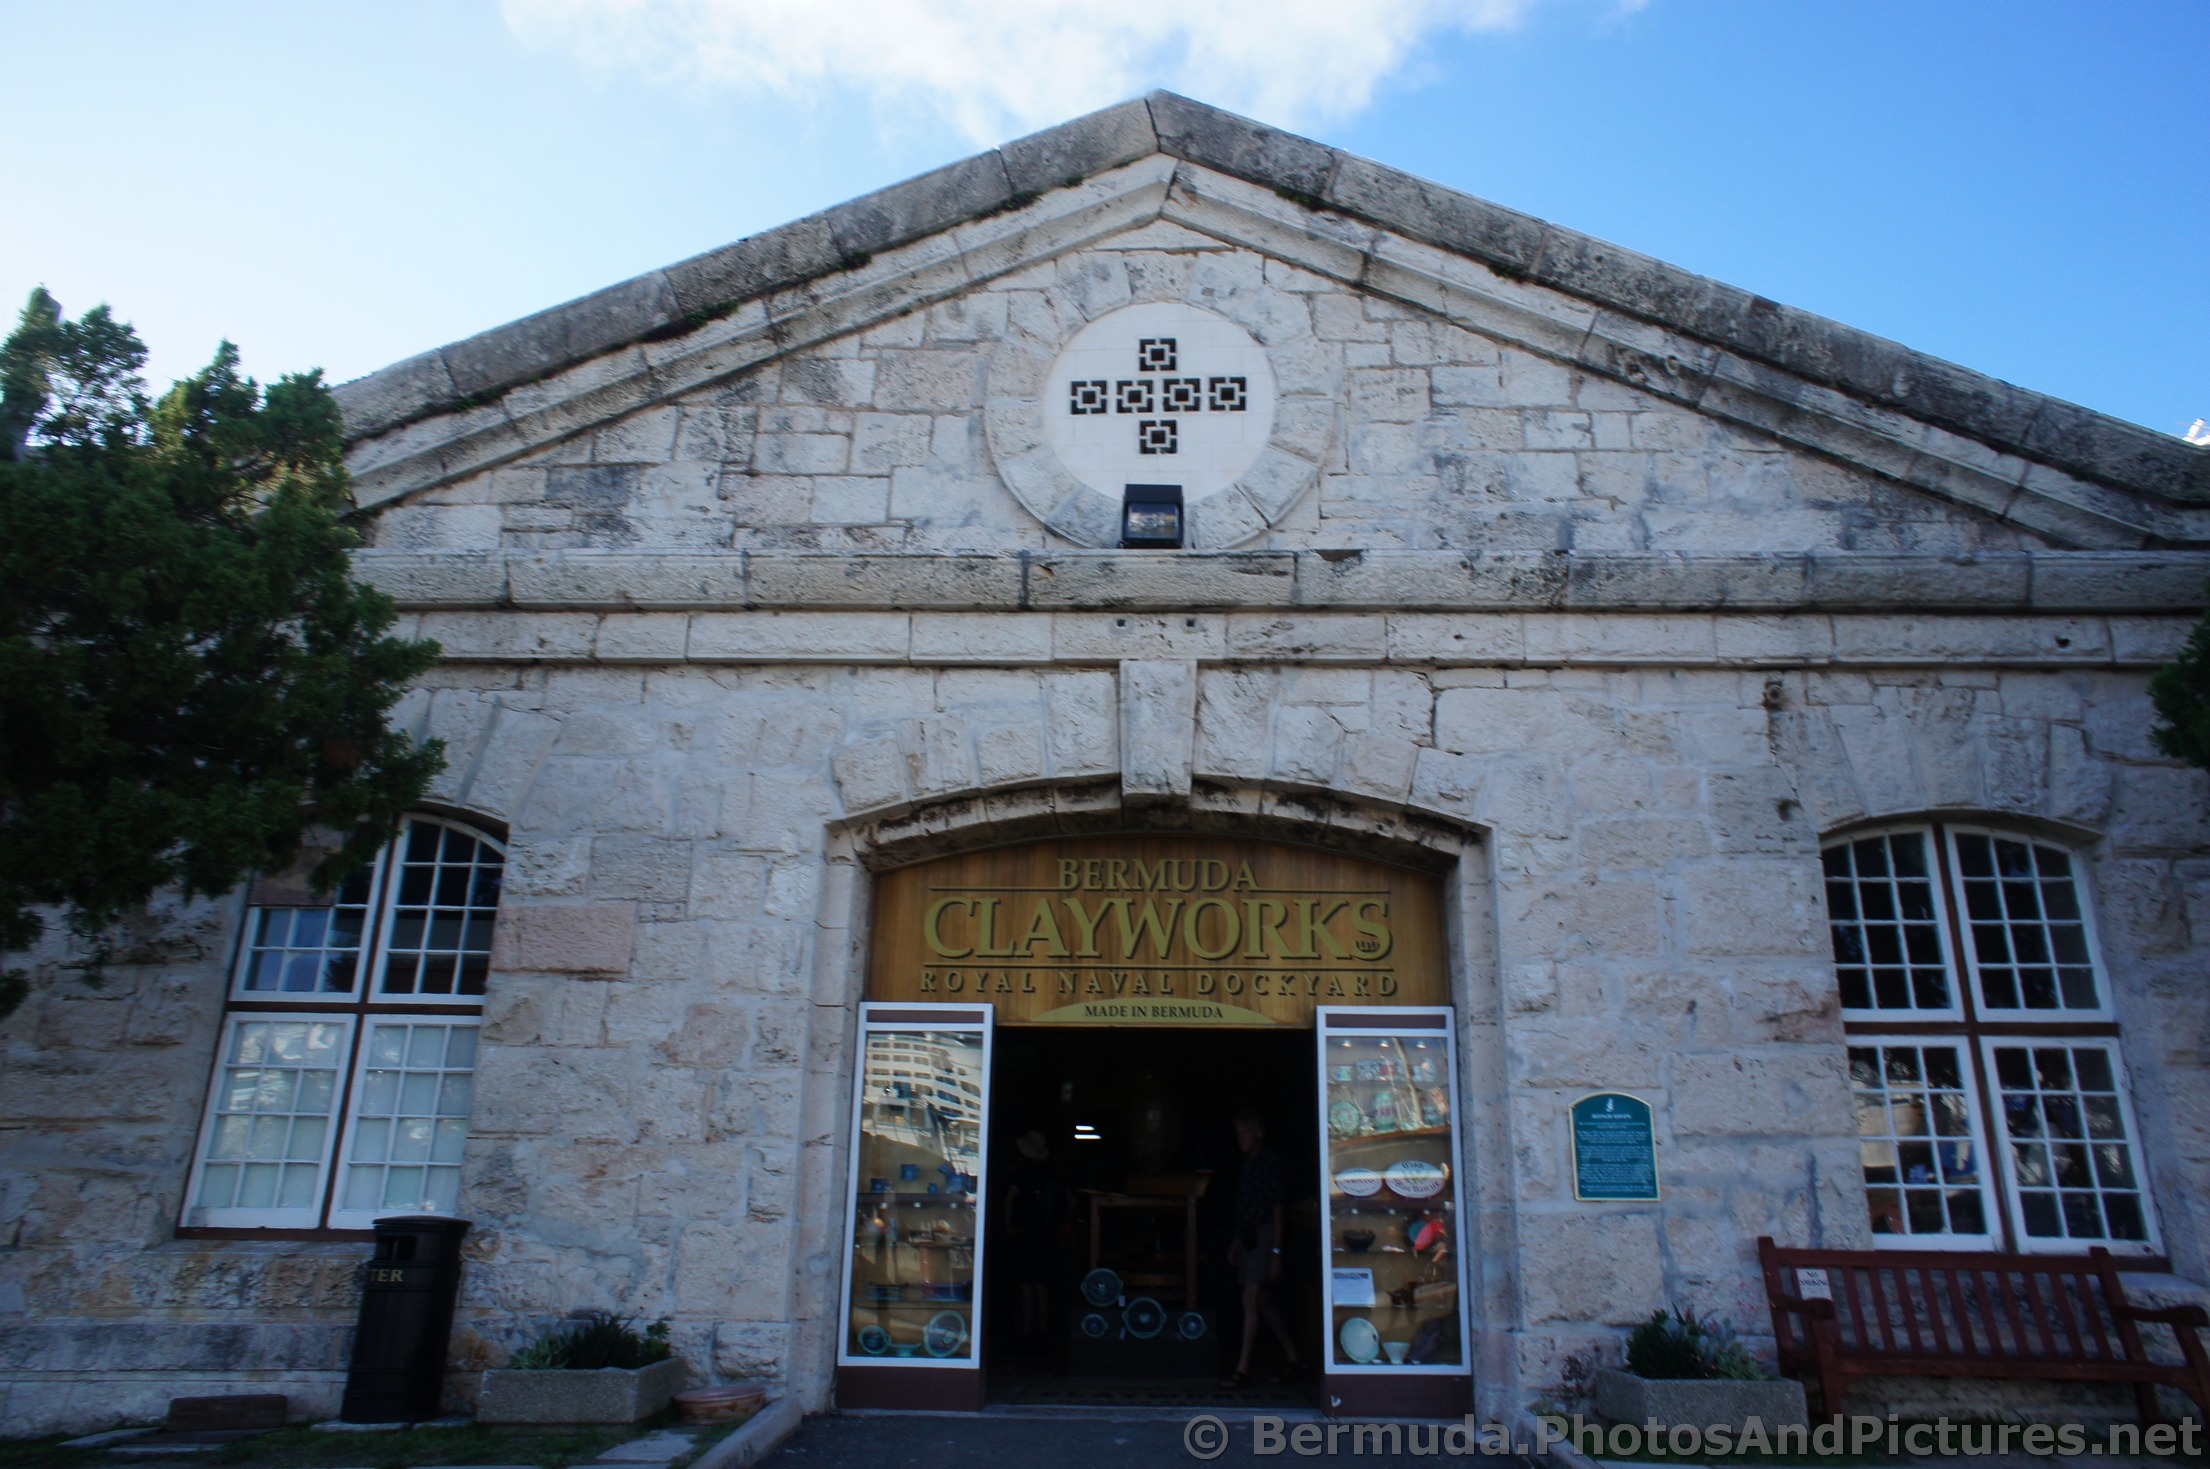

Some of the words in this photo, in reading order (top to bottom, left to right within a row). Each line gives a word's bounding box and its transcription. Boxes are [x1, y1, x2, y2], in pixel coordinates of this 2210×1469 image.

[1056, 858, 1260, 892] BERMUDA
[923, 896, 1393, 960] CLAYWORKS
[920, 970, 1035, 993] ROYAL
[1058, 971, 1174, 995] NAVAL
[1197, 972, 1398, 997] DOCKYARD
[1084, 1005, 1128, 1018] MADE
[1131, 1005, 1148, 1018] IN
[1151, 1005, 1224, 1019] BERMUDA
